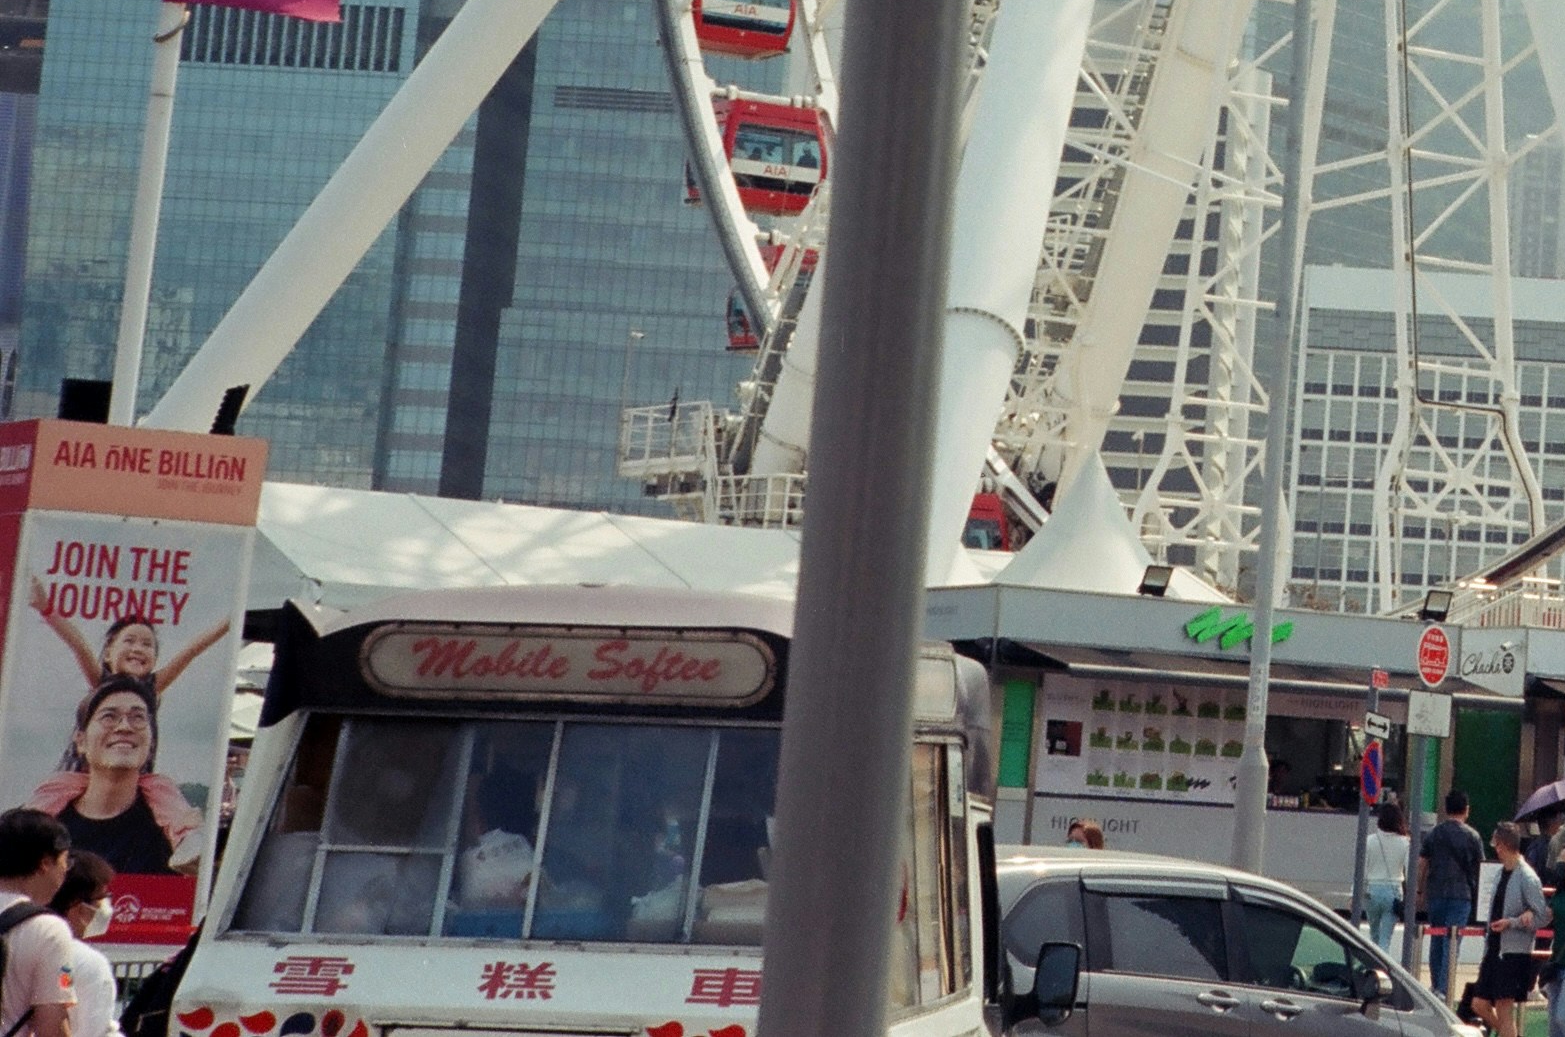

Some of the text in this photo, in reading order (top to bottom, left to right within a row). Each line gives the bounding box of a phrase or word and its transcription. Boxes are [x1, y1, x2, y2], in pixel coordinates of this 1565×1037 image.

[734, 4, 758, 16] AIA
[763, 165, 788, 177] AIA
[53, 440, 97, 469] AIA
[46, 540, 192, 585] JOIN THE
[42, 582, 190, 626] JOURNEY
[412, 636, 723, 692] Mobile Softee
